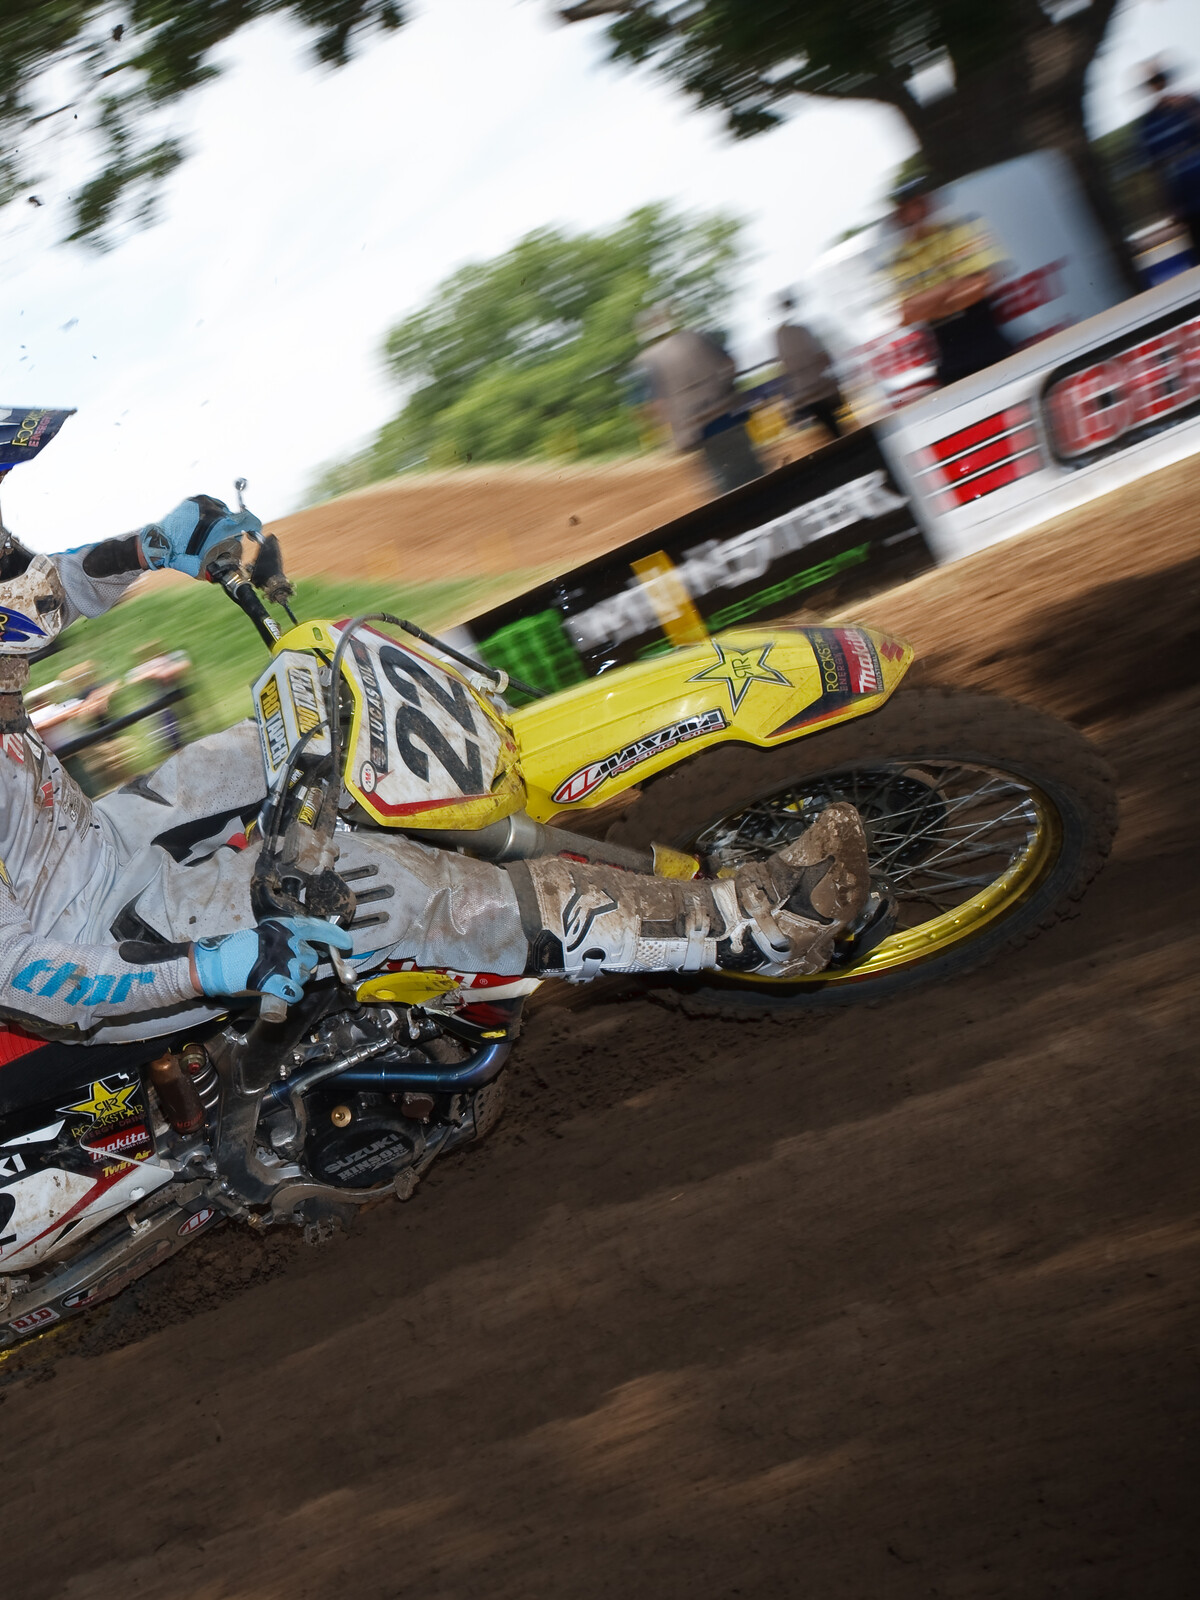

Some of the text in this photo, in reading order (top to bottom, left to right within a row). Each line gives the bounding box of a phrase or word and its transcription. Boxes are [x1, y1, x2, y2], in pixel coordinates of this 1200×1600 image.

[361, 664, 375, 688] OIL
[368, 688, 385, 743] LUCAS
[379, 645, 484, 795] 22
[324, 1133, 399, 1174] SUZUKI
[337, 1143, 405, 1180] HINSON
